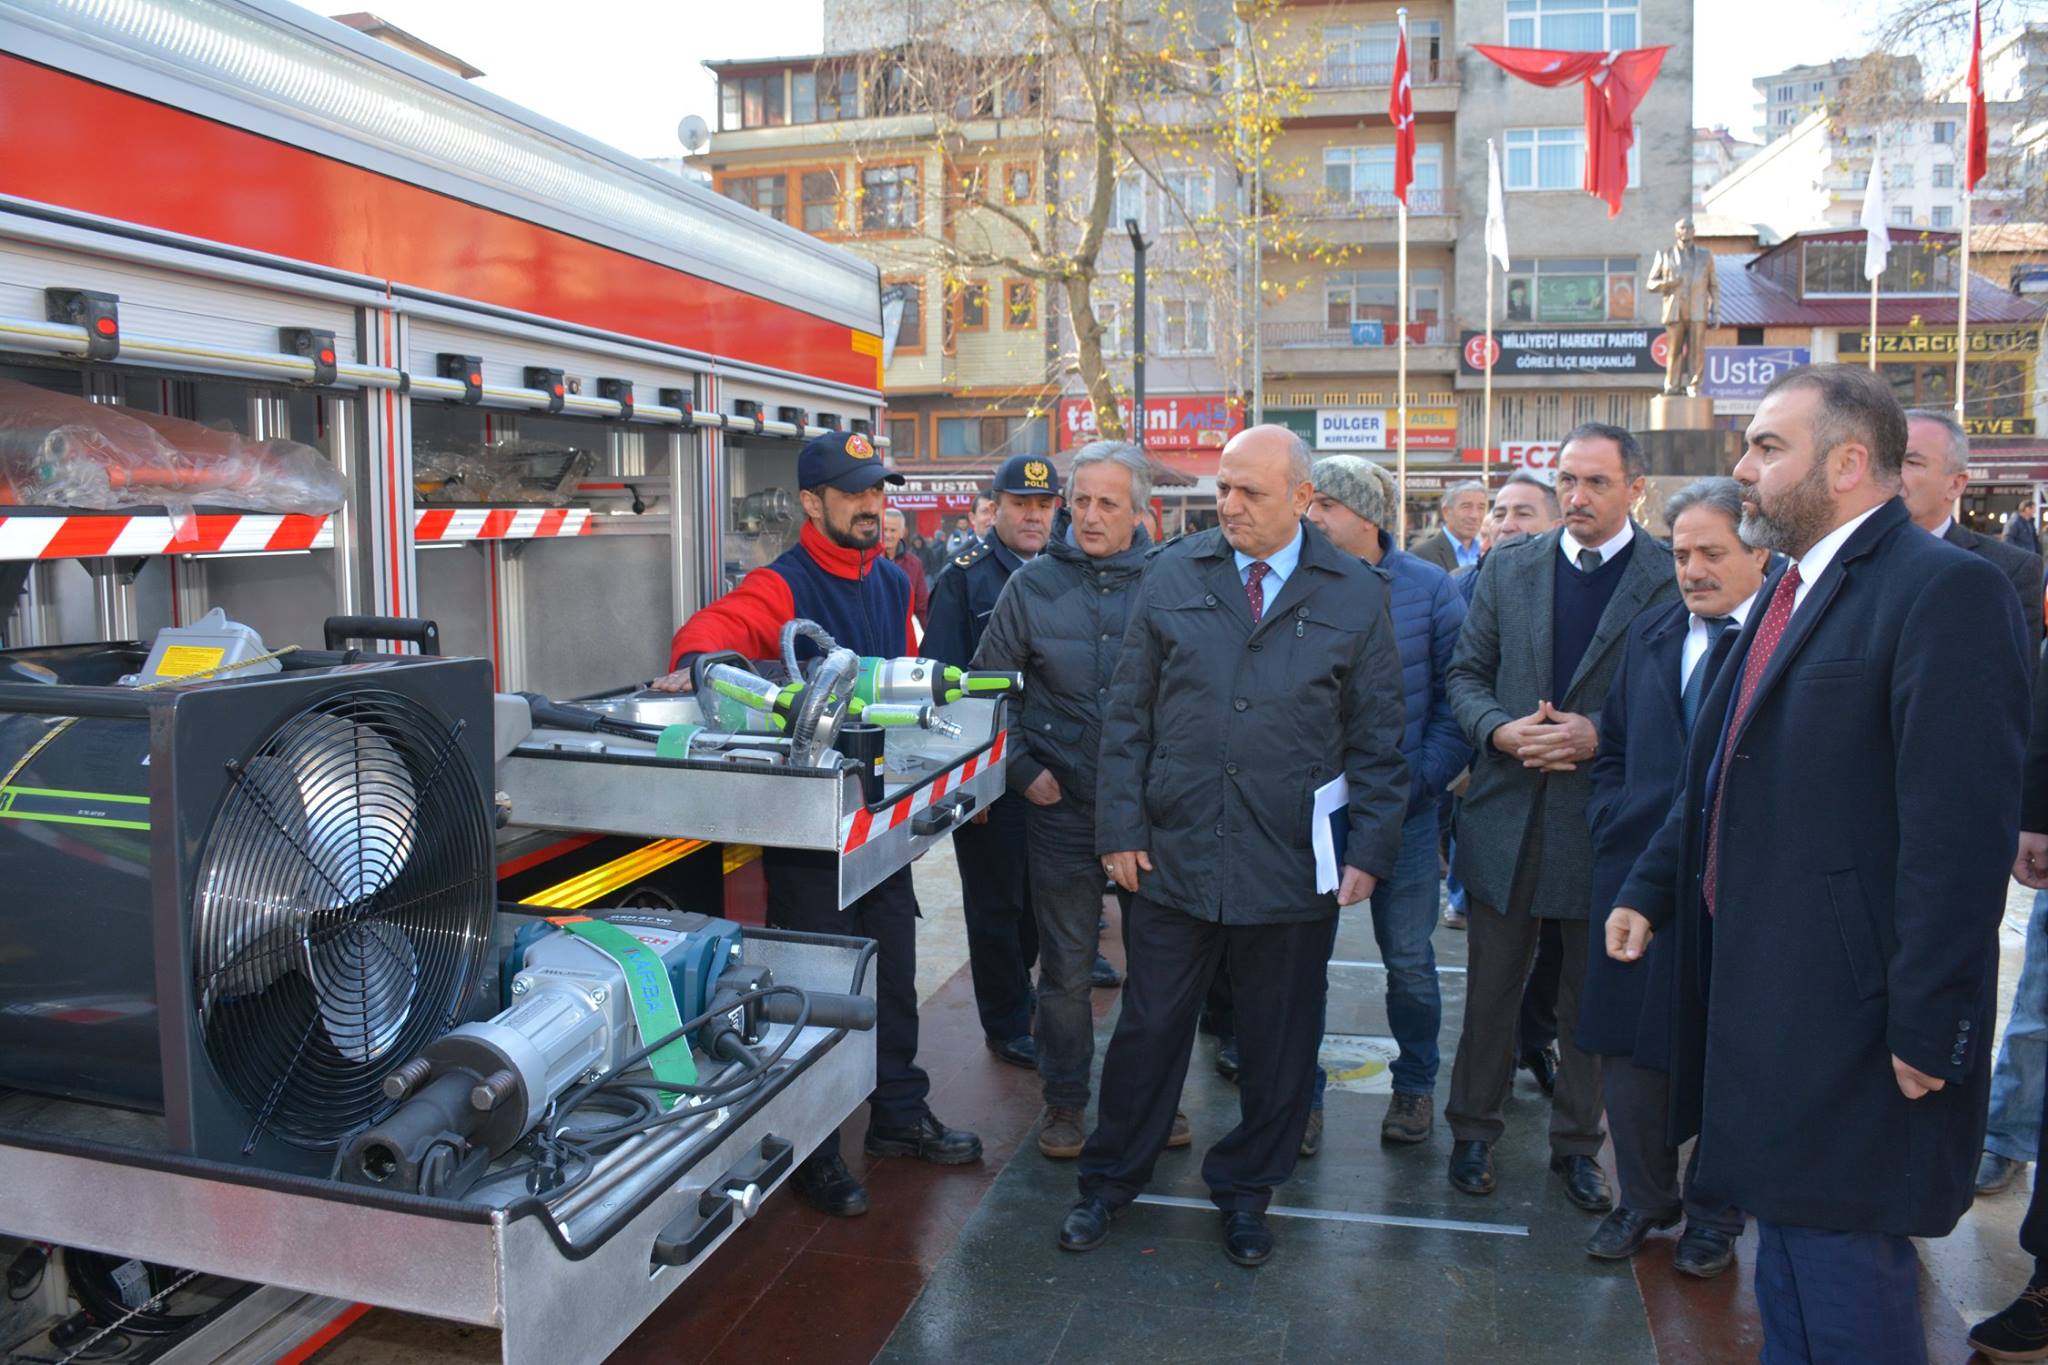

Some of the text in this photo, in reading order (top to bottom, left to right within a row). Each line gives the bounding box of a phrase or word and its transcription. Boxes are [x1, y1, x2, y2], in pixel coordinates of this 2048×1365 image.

[1502, 331, 1647, 349] MİLLİYETÇİ HAREKET PARTİSİ
[1516, 353, 1636, 370] GÖRELE İLÇE BAŞKANLIĞI
[1710, 356, 1775, 384] Usta
[1323, 416, 1379, 430] DÜLGER
[1411, 414, 1447, 425] ADEL
[1963, 420, 2013, 434] EYVE
[1325, 435, 1377, 443] KIRTASİYE
[1508, 446, 1561, 468] ECZ
[931, 481, 978, 492] USTA
